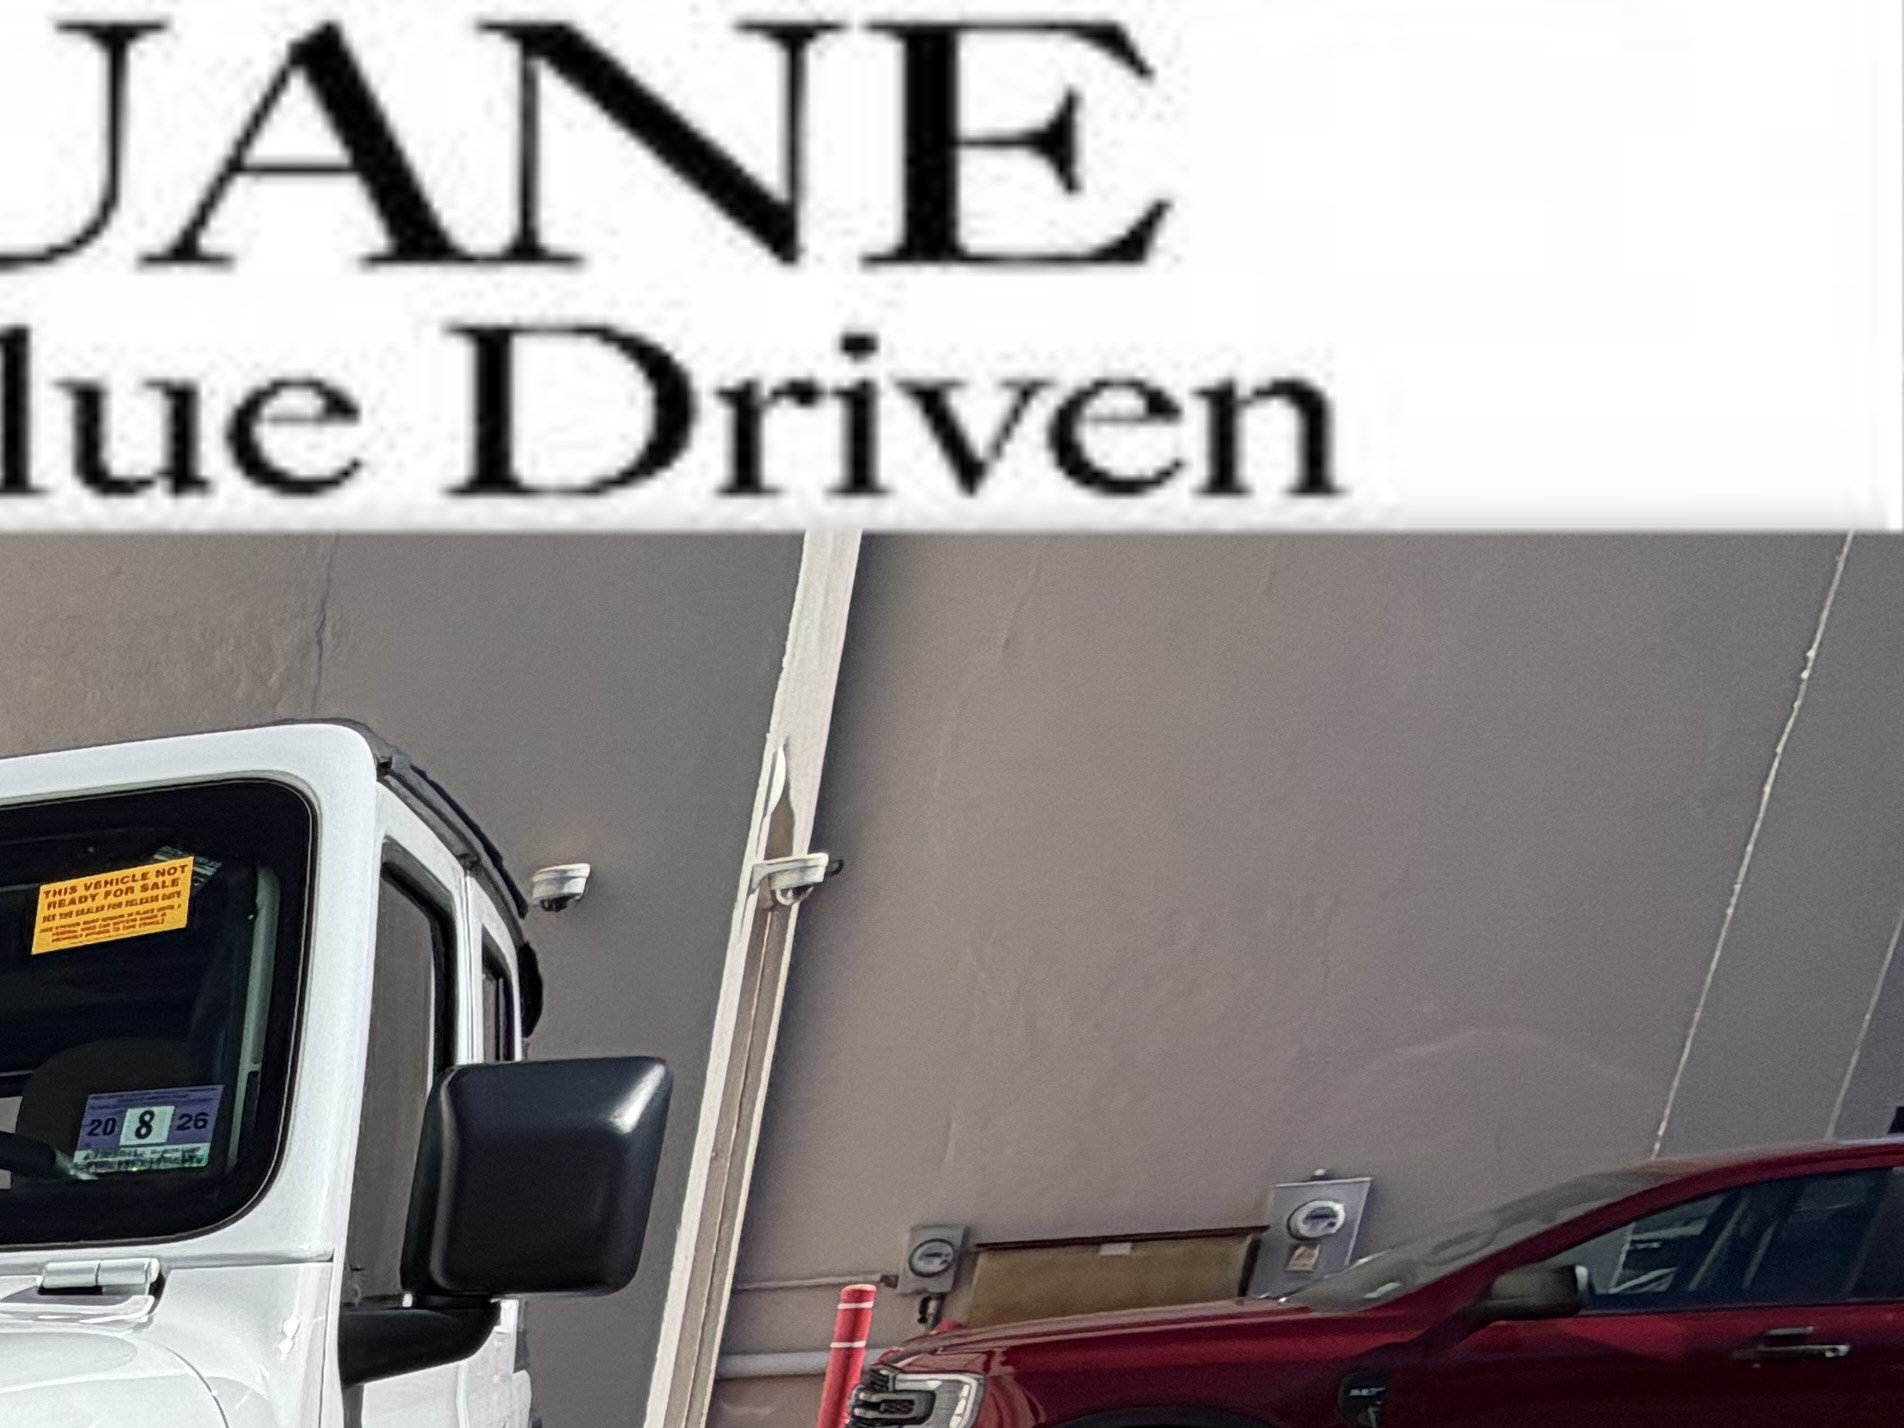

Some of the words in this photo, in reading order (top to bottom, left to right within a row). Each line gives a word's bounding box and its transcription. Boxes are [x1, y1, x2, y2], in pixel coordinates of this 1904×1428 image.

[43, 885, 78, 900] THIS
[84, 871, 150, 893] VEHICLE
[155, 864, 188, 878] NOT
[47, 893, 99, 911] READY
[104, 885, 135, 900] FOR
[141, 878, 180, 893] SALE
[87, 1117, 117, 1136] 20
[134, 1110, 156, 1140] 8
[176, 1112, 210, 1132] 26
